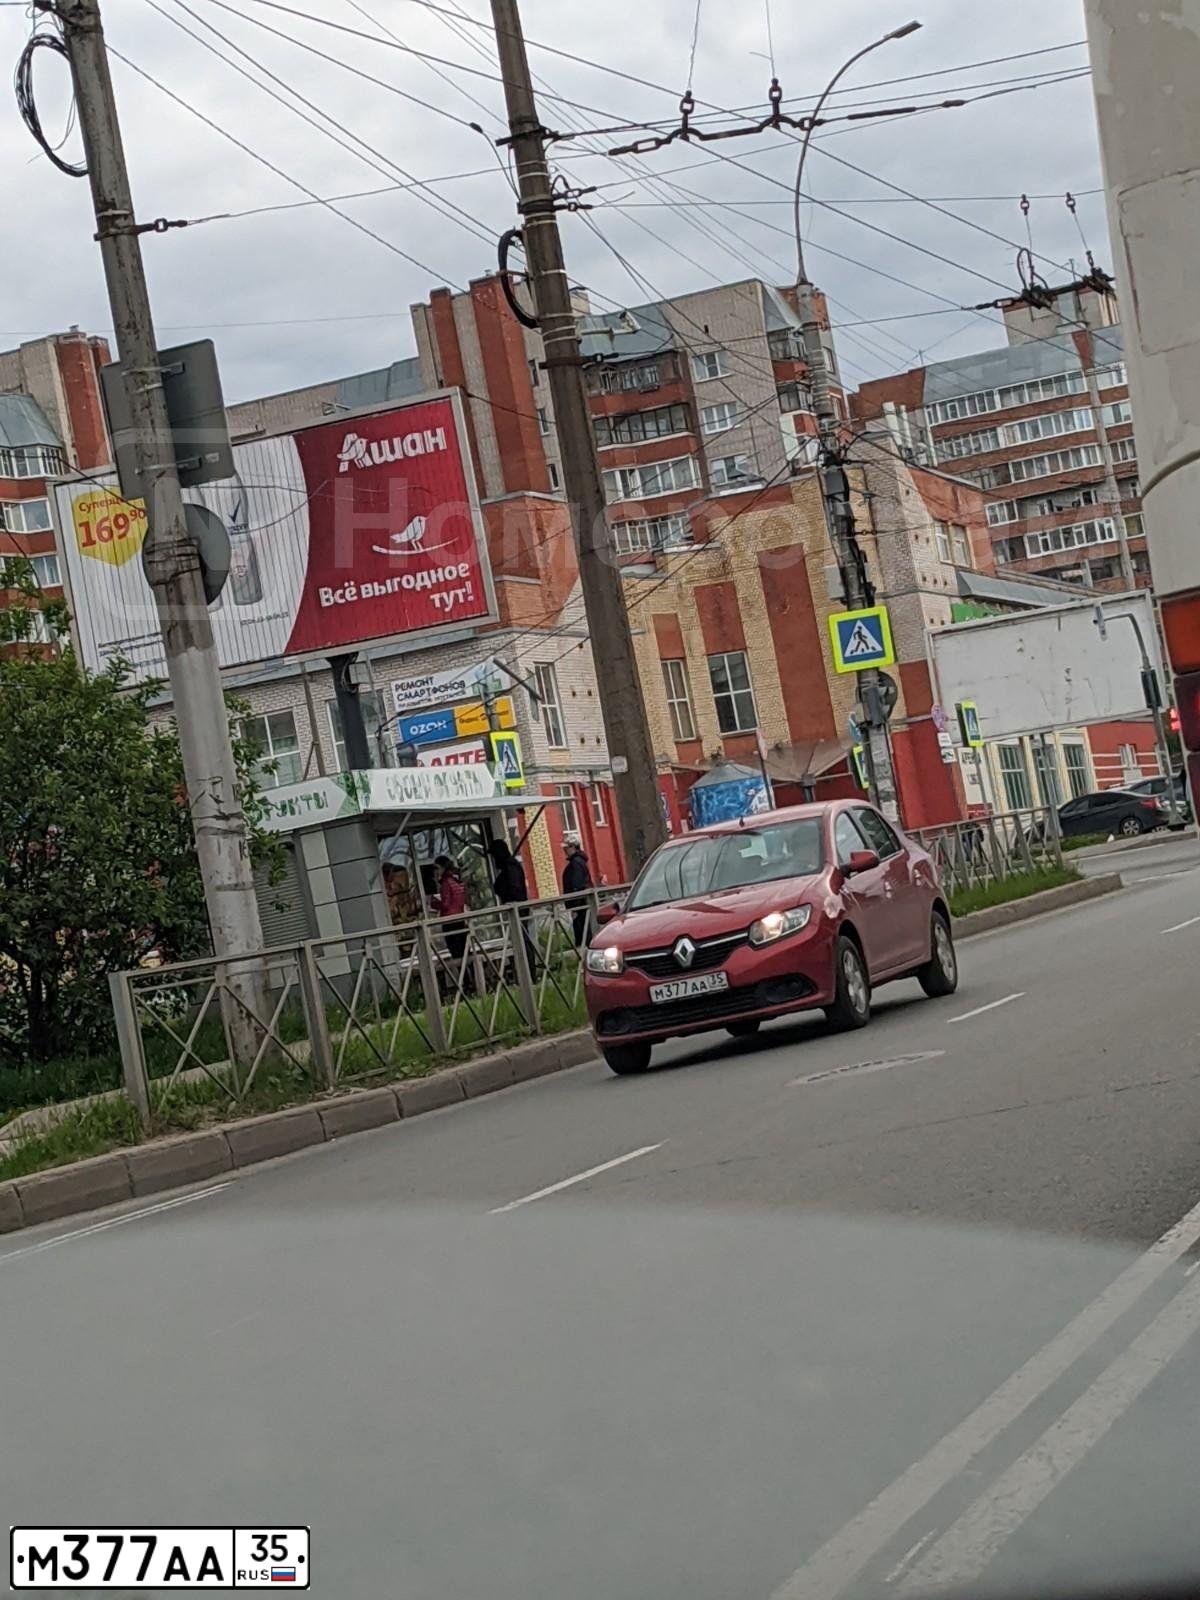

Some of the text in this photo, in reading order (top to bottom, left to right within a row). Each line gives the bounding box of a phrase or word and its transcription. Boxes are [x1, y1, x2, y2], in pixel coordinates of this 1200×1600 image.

[337, 427, 448, 472] Ашан
[319, 562, 470, 607] Всё выгодное
[430, 582, 474, 612] тут!
[394, 676, 434, 692] РЕМОНТ
[396, 680, 466, 701] СМАРТФОНОВ
